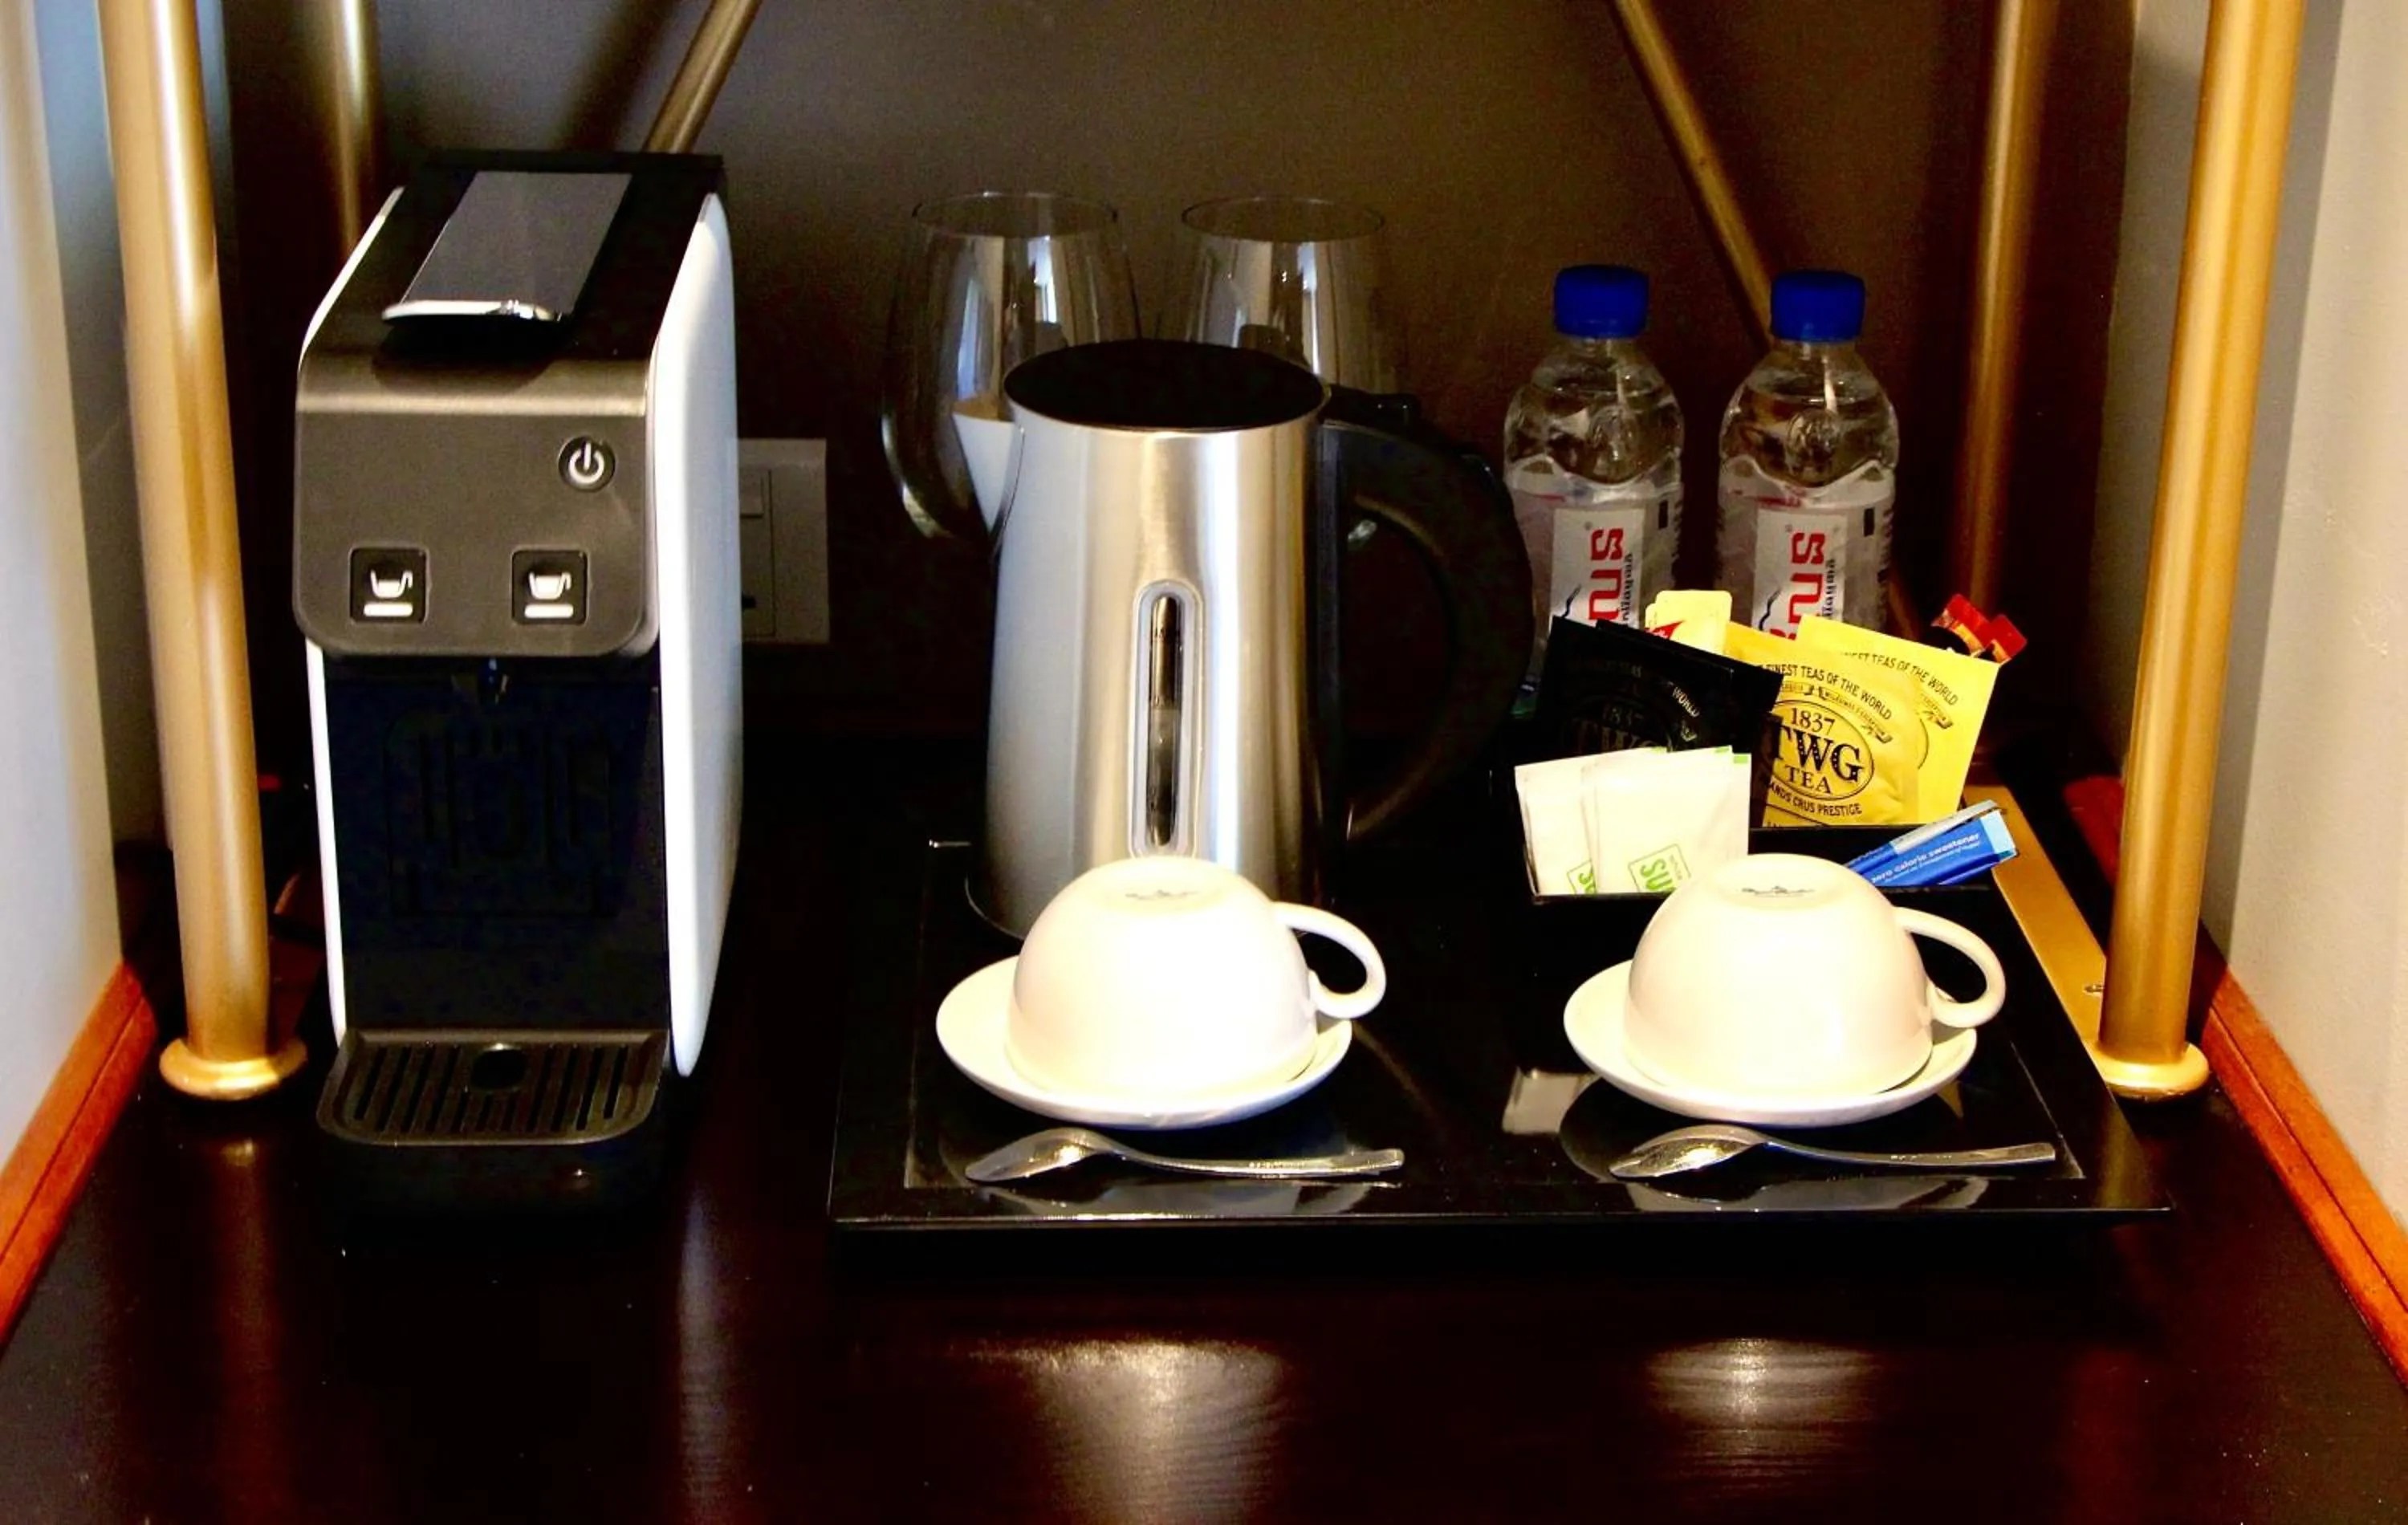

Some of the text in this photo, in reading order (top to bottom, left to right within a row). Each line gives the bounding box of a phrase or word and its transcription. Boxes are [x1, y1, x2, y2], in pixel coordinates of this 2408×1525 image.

[1800, 665, 1824, 681] TEAS
[1826, 671, 1840, 686] OF
[1841, 678, 1860, 697] THE
[1861, 689, 1893, 721] WORLD
[1898, 660, 1910, 671] OF
[1912, 665, 1930, 683] THE
[1928, 677, 1959, 706] WORLD
[1672, 686, 1701, 718] WORLD
[1791, 707, 1836, 736] 1837
[1784, 765, 1832, 795] TEA
[1792, 796, 1815, 813] CRUS
[1816, 803, 1863, 817] PRESTIGE
[1894, 853, 1927, 873] calorie
[1928, 833, 1980, 857] sweetener
